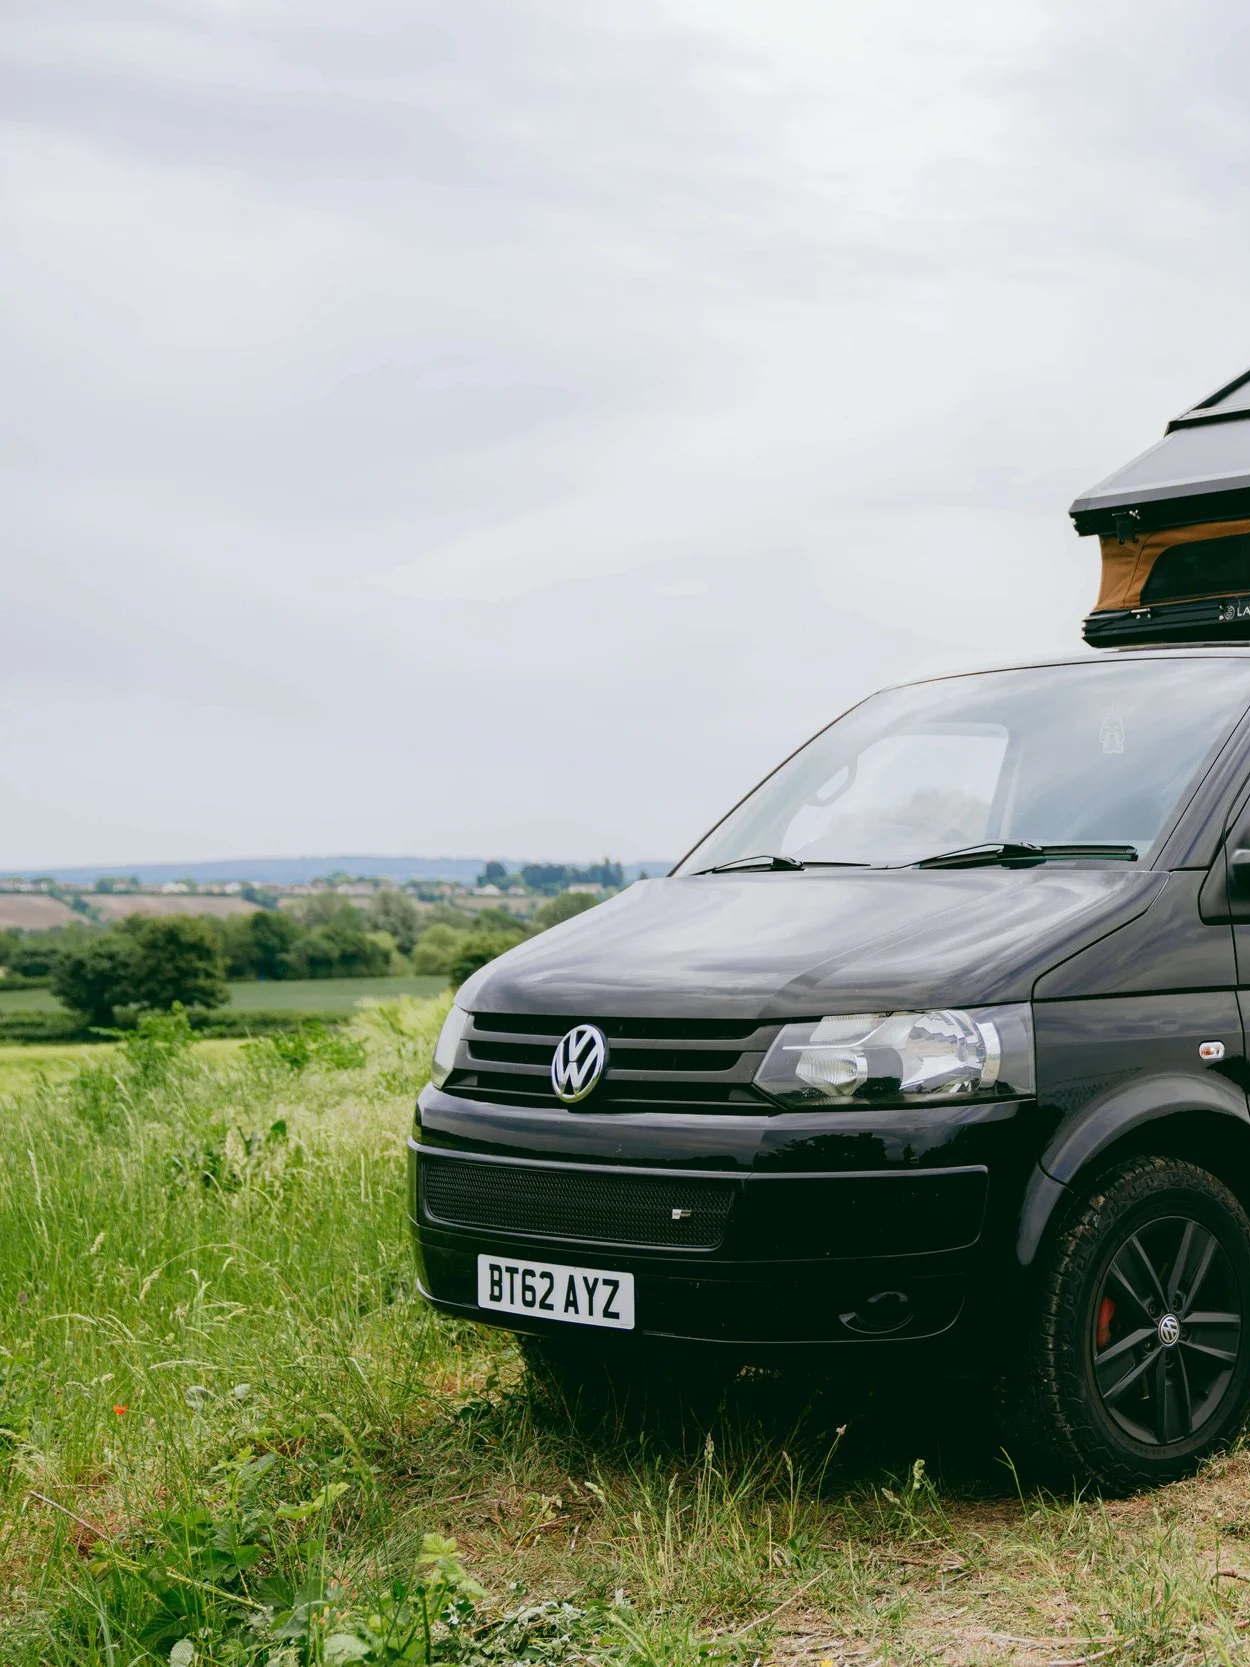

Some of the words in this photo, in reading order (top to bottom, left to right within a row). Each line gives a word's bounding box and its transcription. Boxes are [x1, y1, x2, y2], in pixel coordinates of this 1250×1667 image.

[552, 1025, 605, 1102] VW
[489, 1263, 555, 1311] BT62
[563, 1274, 620, 1320] AYZ
